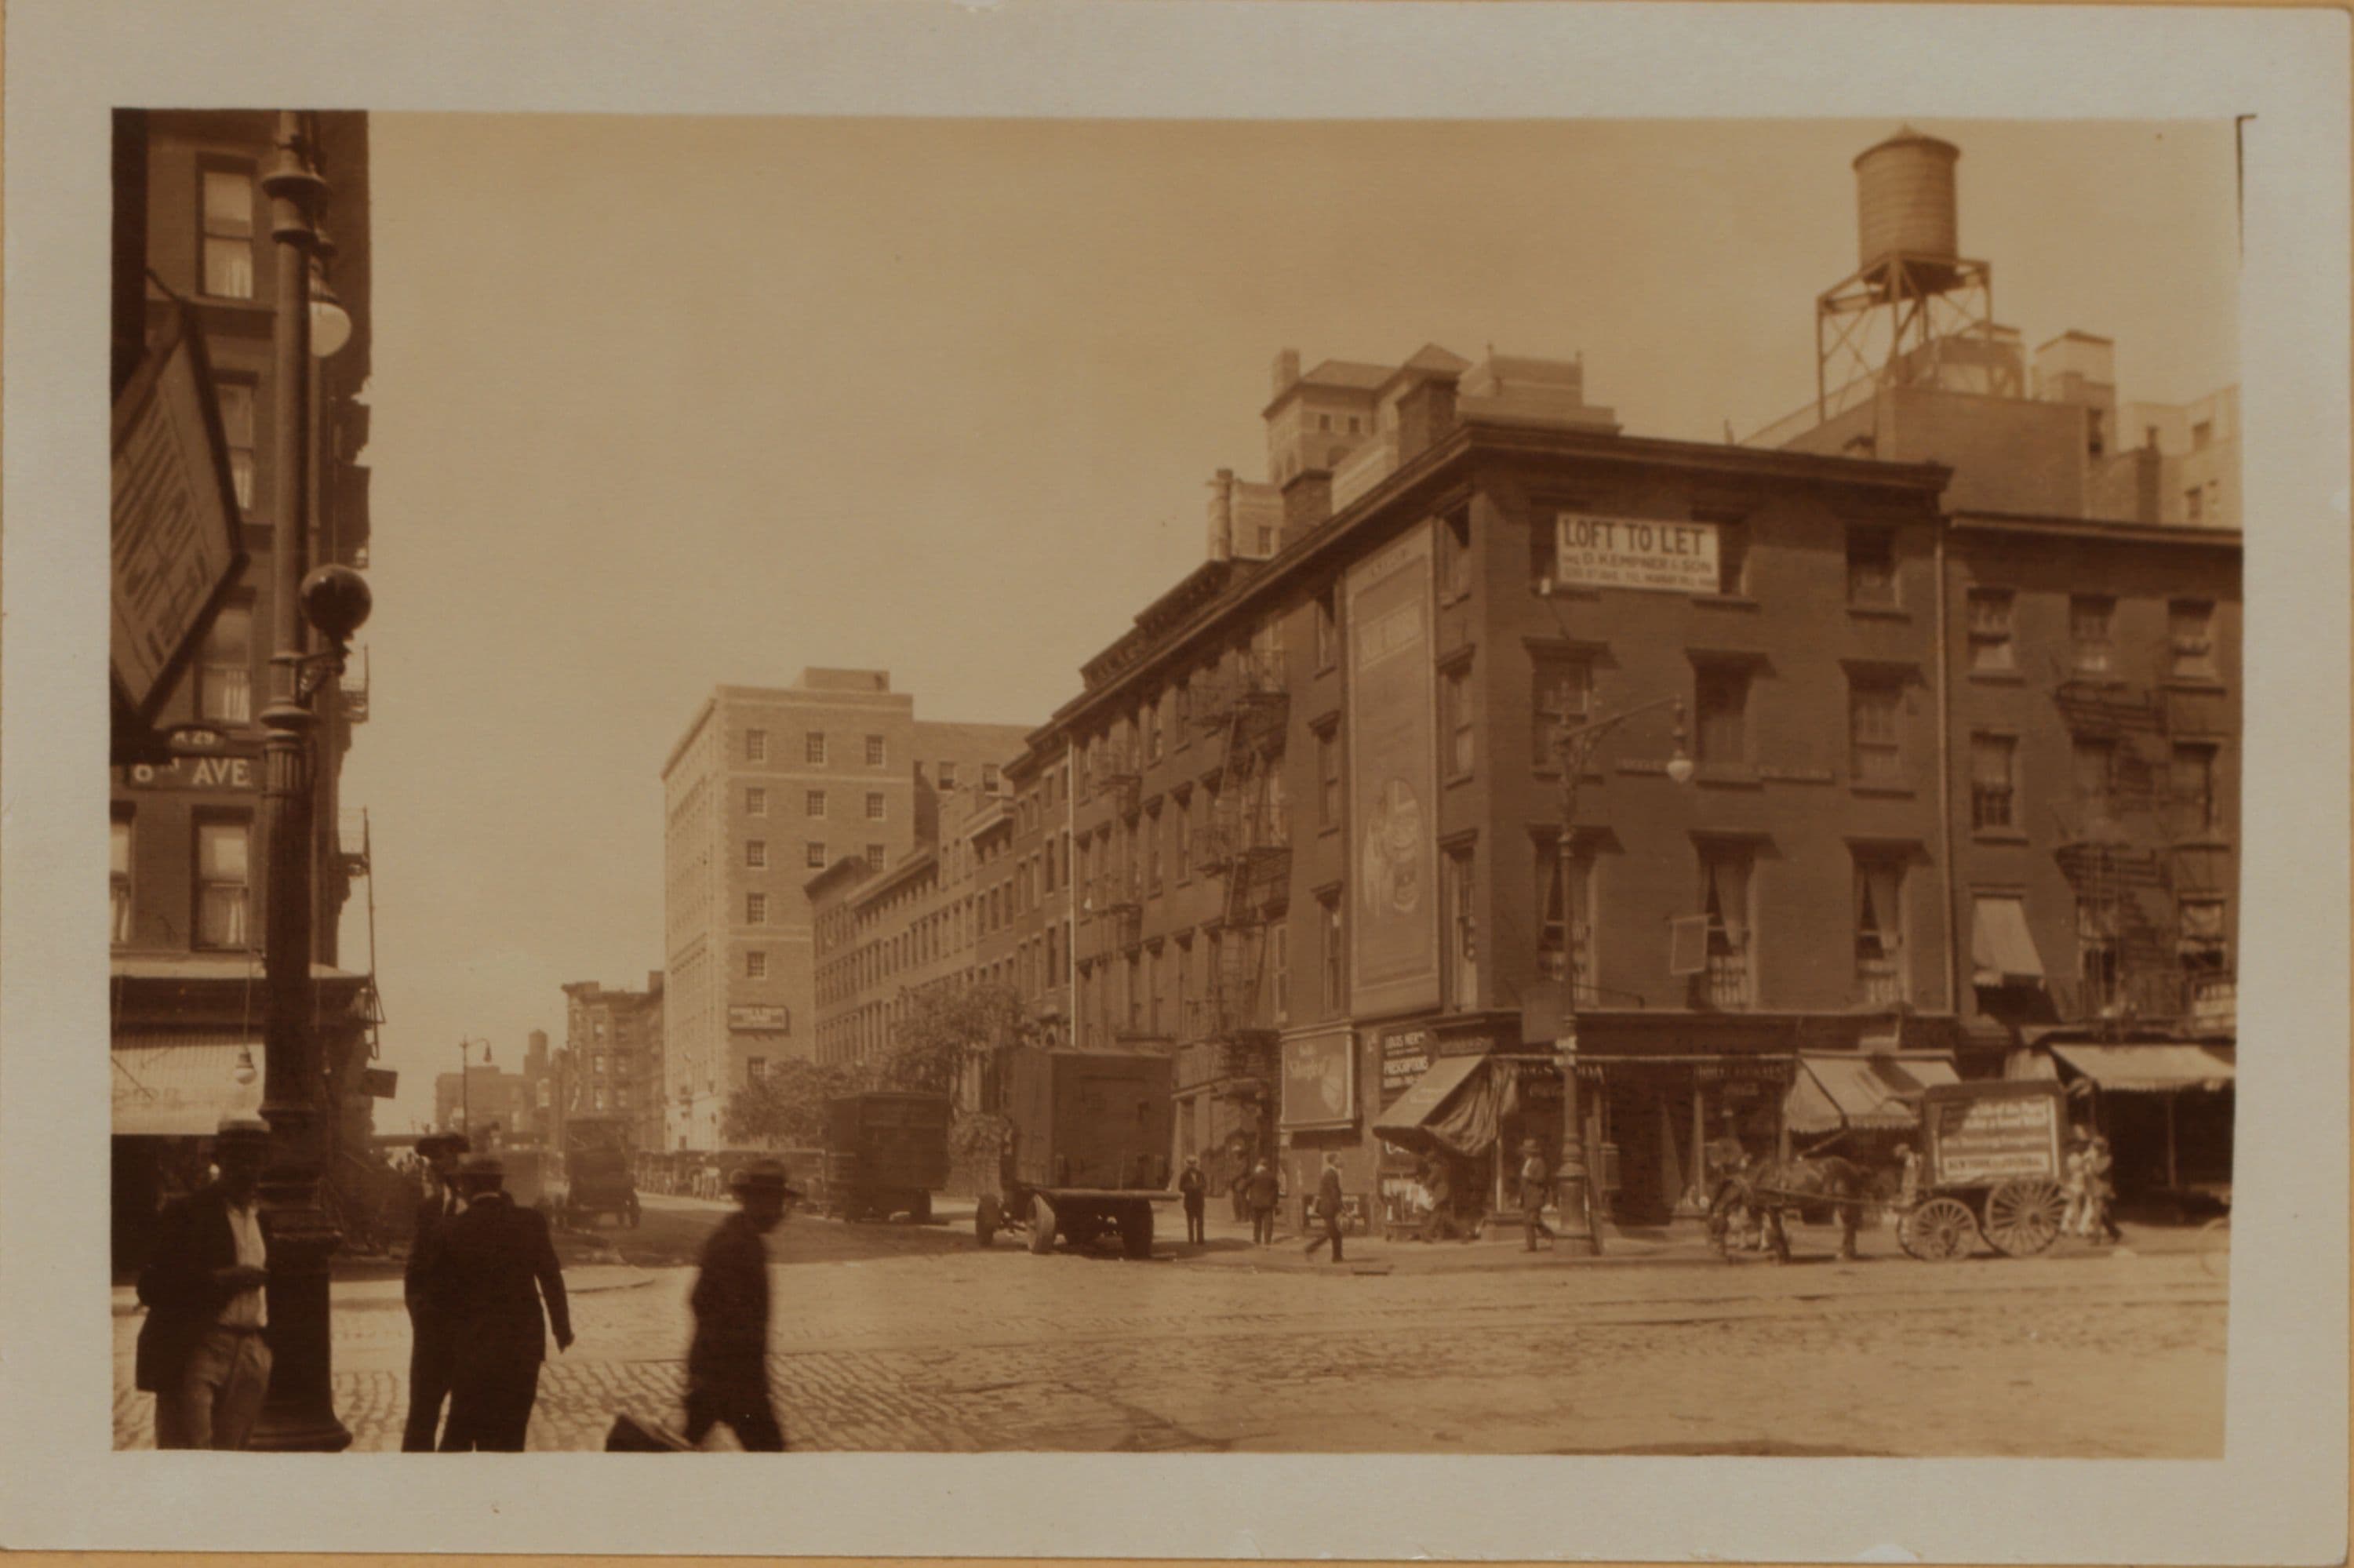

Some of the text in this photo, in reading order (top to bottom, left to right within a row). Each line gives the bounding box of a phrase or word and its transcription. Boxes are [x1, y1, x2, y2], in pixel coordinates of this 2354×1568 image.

[1563, 518, 1705, 556] LOFT TO LET
[191, 758, 253, 787] AVE
